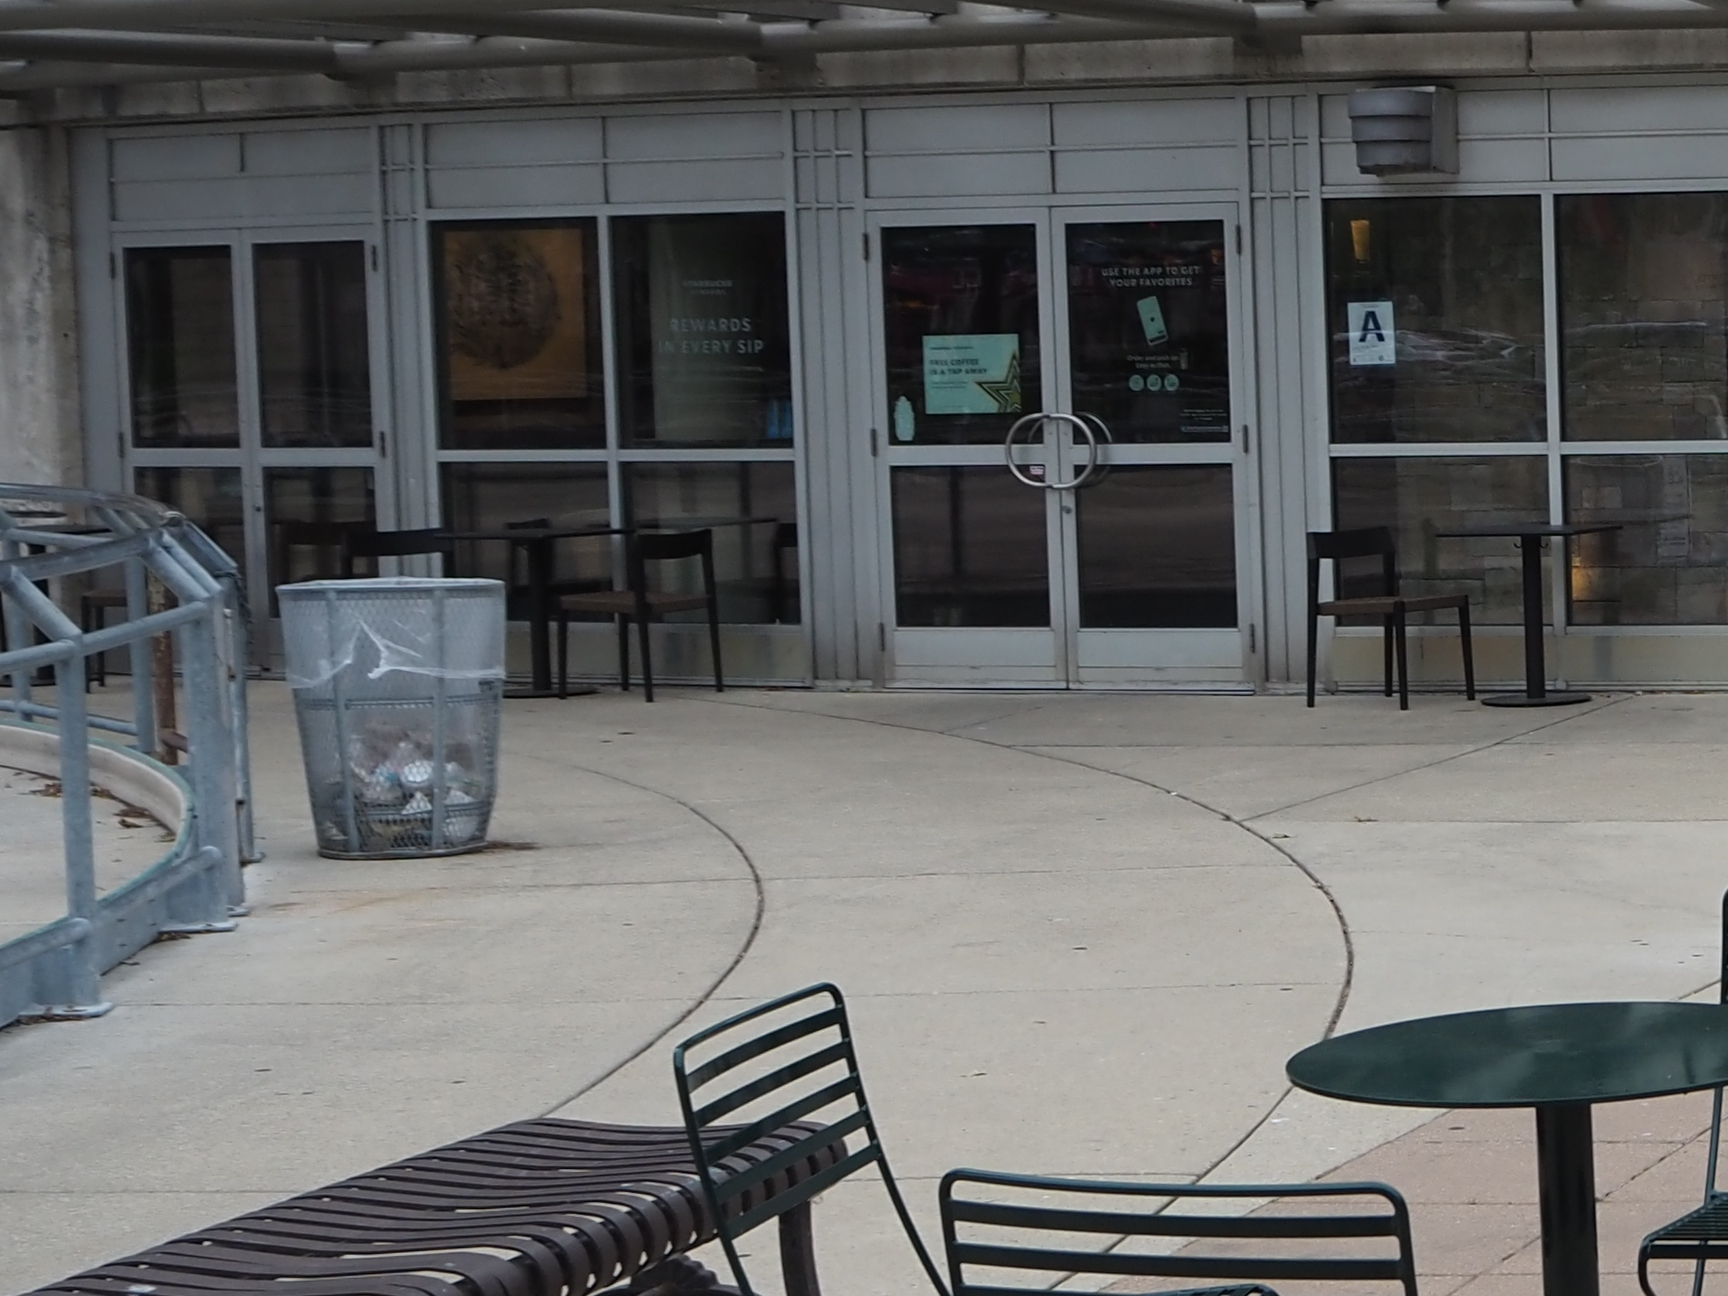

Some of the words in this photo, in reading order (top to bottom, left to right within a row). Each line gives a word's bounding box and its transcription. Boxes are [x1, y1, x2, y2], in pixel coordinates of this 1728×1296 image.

[1101, 268, 1119, 277] USE
[1121, 267, 1140, 276] THE
[1142, 266, 1163, 276] APP
[1165, 266, 1179, 275] TO
[1181, 266, 1200, 275] GET
[1109, 278, 1138, 287] YOUR
[1139, 277, 1193, 287] FAVORITES
[669, 318, 752, 332] REWARDS
[1358, 310, 1385, 343] A
[658, 340, 676, 353] IN
[681, 339, 733, 354] EVERY
[737, 339, 764, 354] SIP
